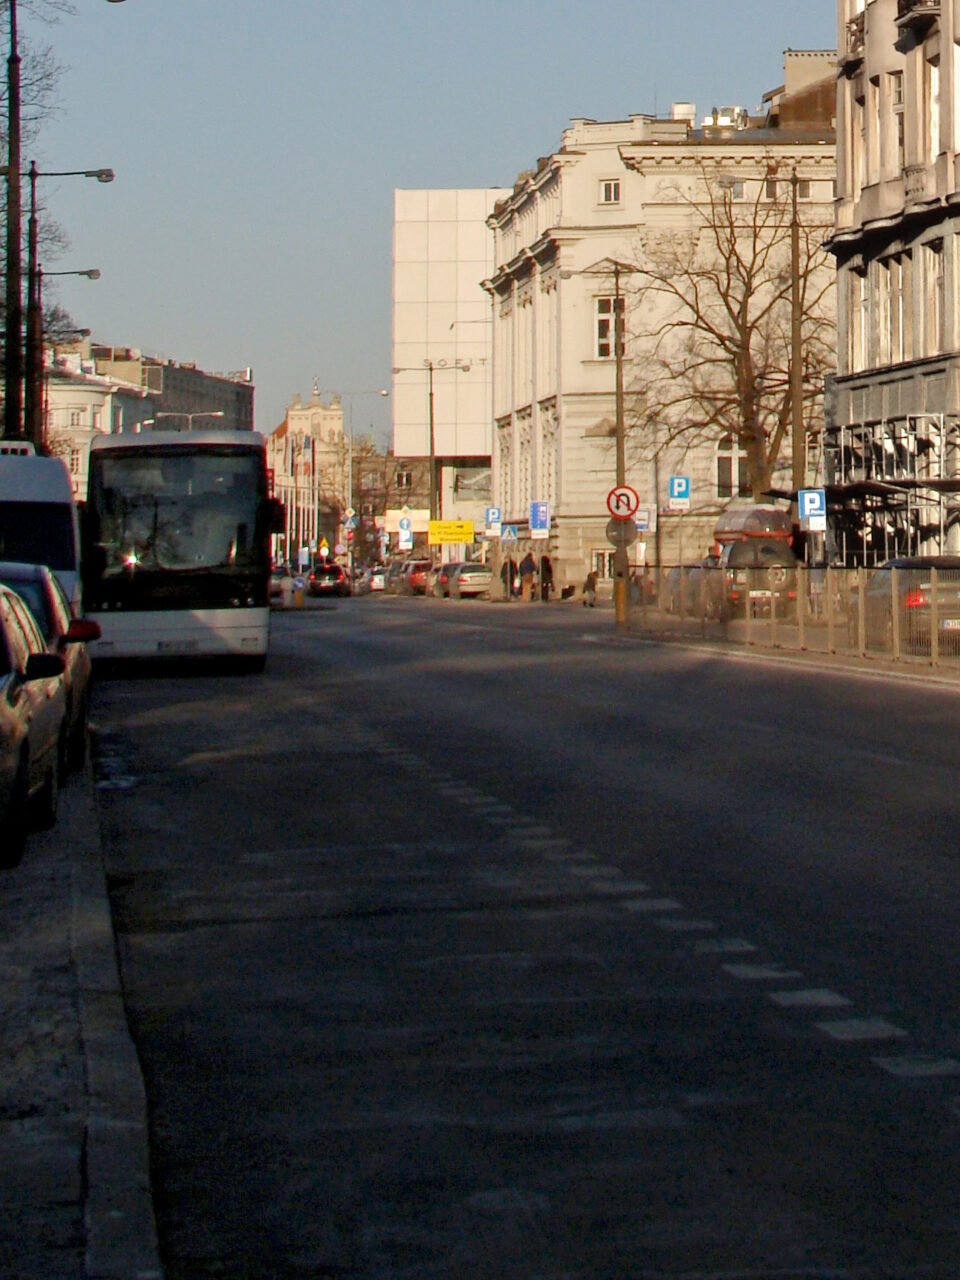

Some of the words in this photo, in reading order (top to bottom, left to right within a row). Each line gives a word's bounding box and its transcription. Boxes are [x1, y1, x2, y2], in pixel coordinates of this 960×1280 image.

[673, 478, 687, 497] P
[804, 492, 821, 515] P
[488, 508, 499, 522] P
